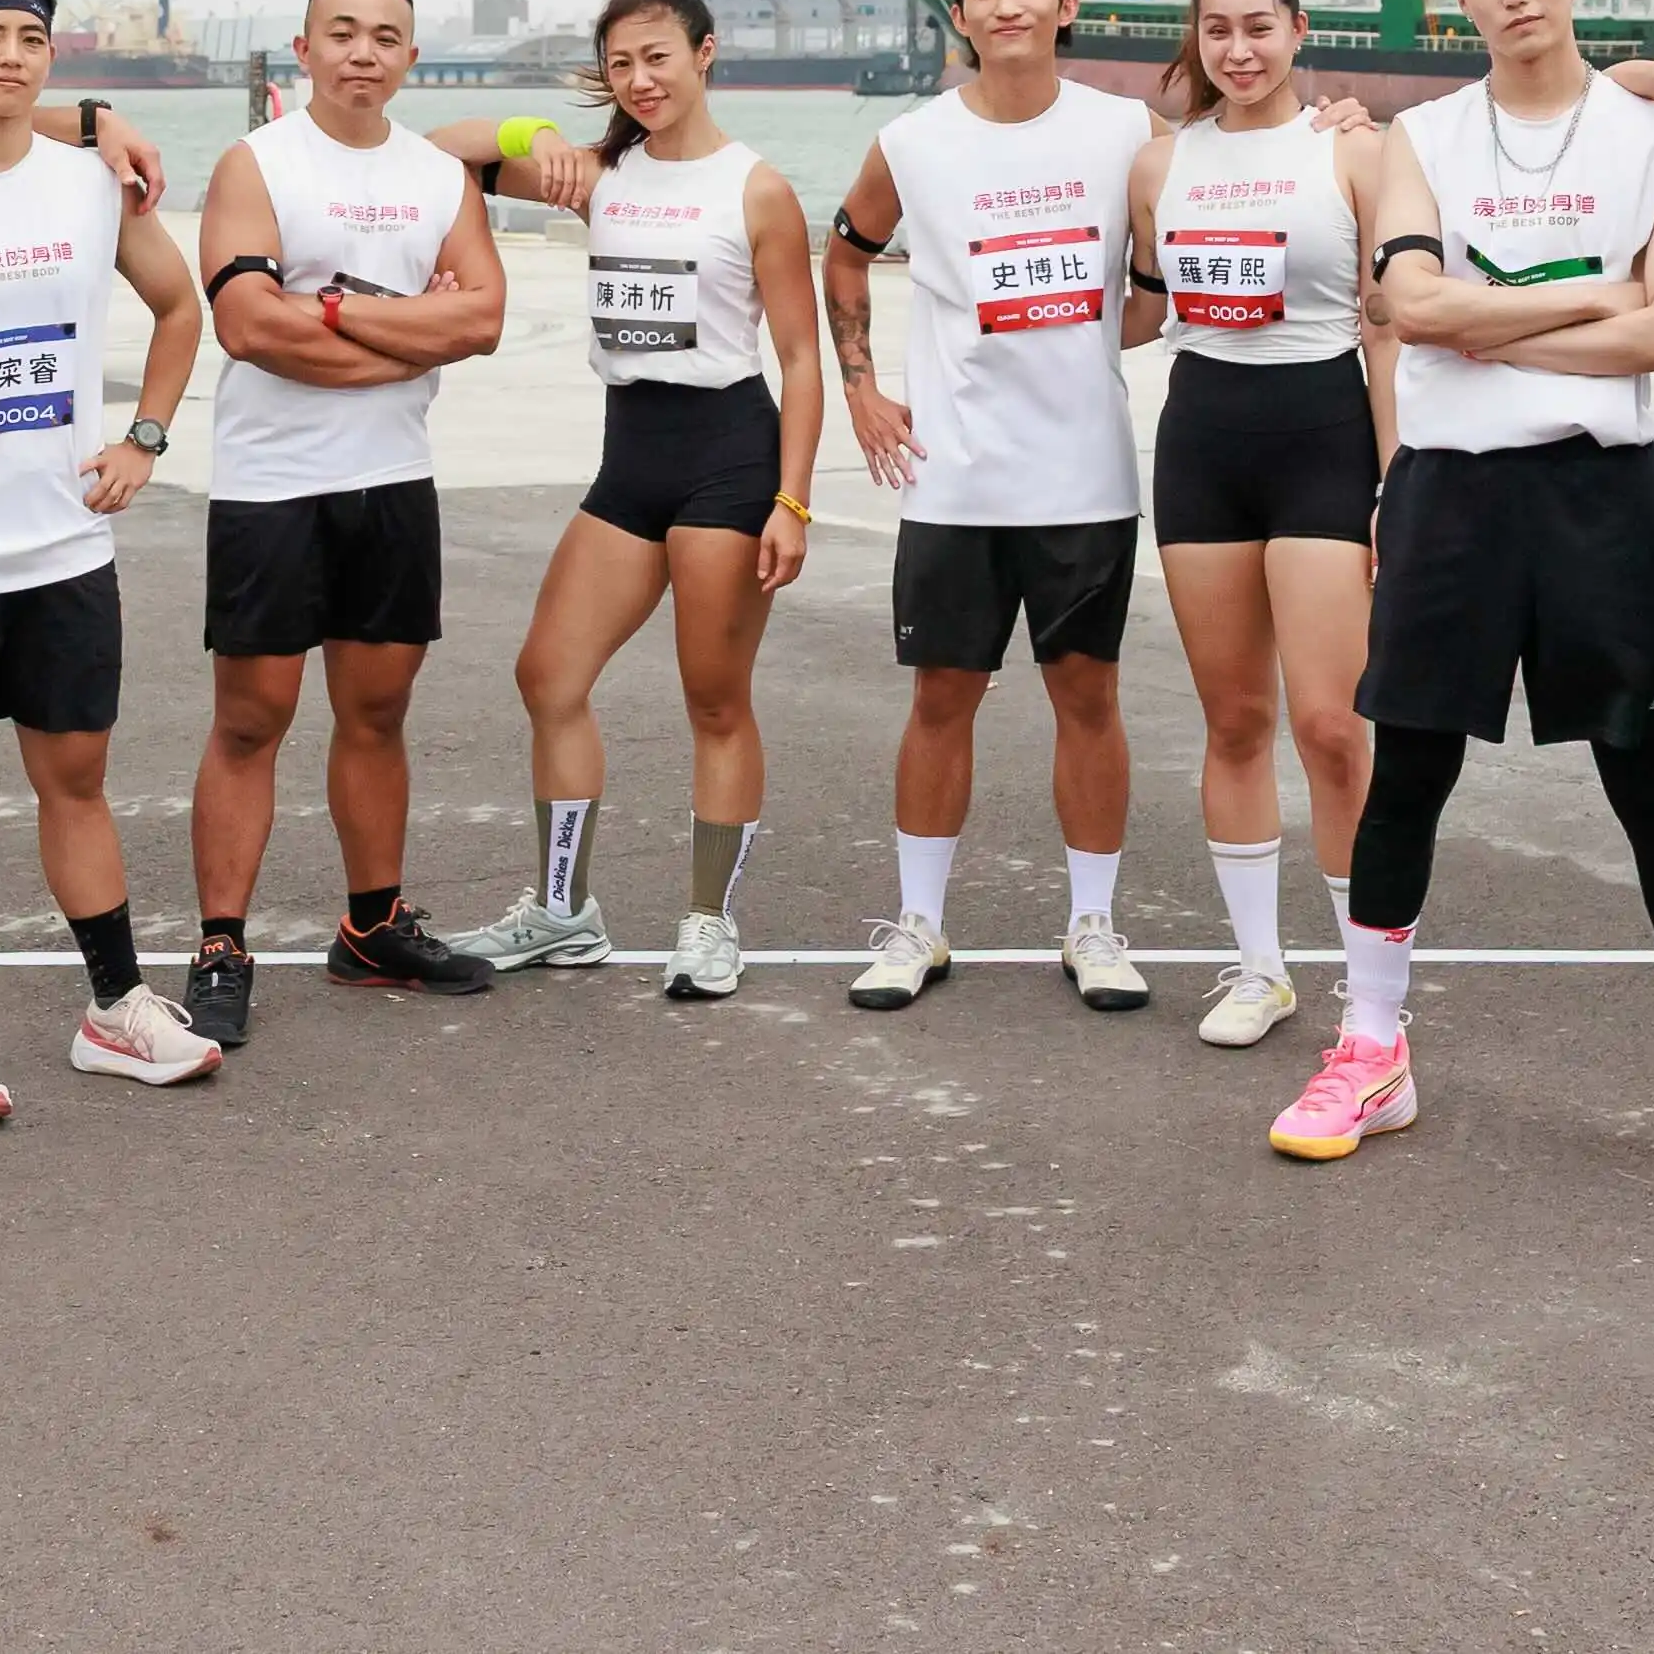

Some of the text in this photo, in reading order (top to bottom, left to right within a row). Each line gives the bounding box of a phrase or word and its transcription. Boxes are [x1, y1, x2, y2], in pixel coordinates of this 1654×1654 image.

[973, 180, 1086, 211] 最強的身體
[1472, 193, 1596, 218] 最強的身體
[990, 202, 1073, 221] THE BEST BODY
[1512, 217, 1544, 227] BEST
[1548, 215, 1580, 227] BODY
[0, 269, 27, 282] BEST
[32, 266, 61, 278] BODY
[992, 253, 1088, 291] 史博比
[1178, 256, 1266, 286] 羅宥熙
[596, 281, 675, 311] 陳沛忻
[1027, 301, 1090, 321] 0004
[1208, 305, 1266, 321] 0004
[617, 329, 677, 345] 0004
[552, 809, 578, 903] Dickies Dickies
[203, 941, 225, 955] TYR
